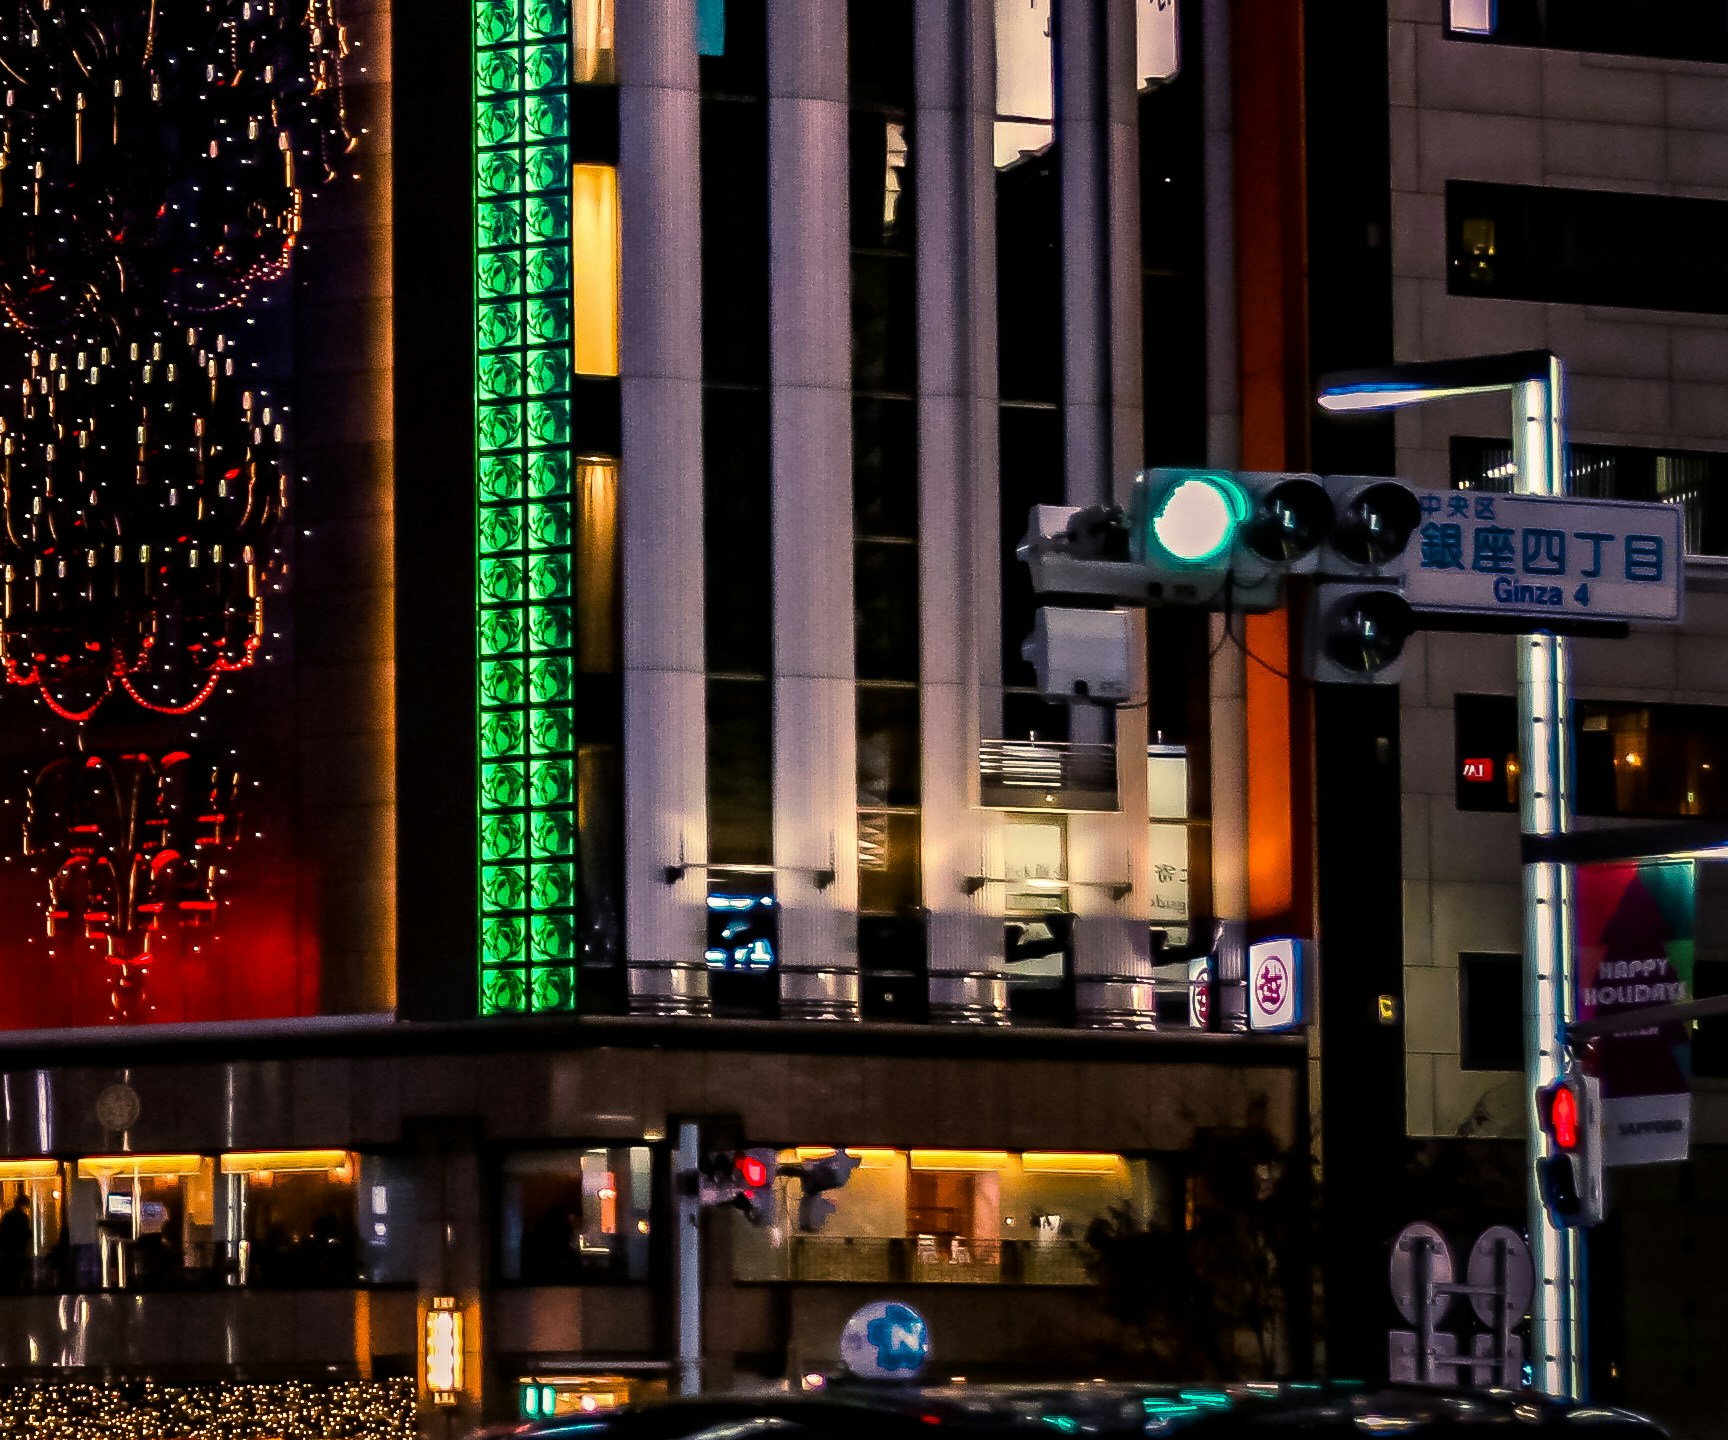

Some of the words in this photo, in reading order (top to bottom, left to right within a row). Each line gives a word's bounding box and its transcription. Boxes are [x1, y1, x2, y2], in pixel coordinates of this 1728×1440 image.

[1421, 496, 1498, 521] 中央区
[1420, 522, 1665, 583] 銀座四丁目
[1493, 575, 1563, 608] Ginza
[1574, 582, 1591, 608] 4
[1598, 959, 1670, 981] HAPPY
[1583, 981, 1687, 1007] HOLIDAYS
[1617, 1118, 1683, 1137] SAPPORO
